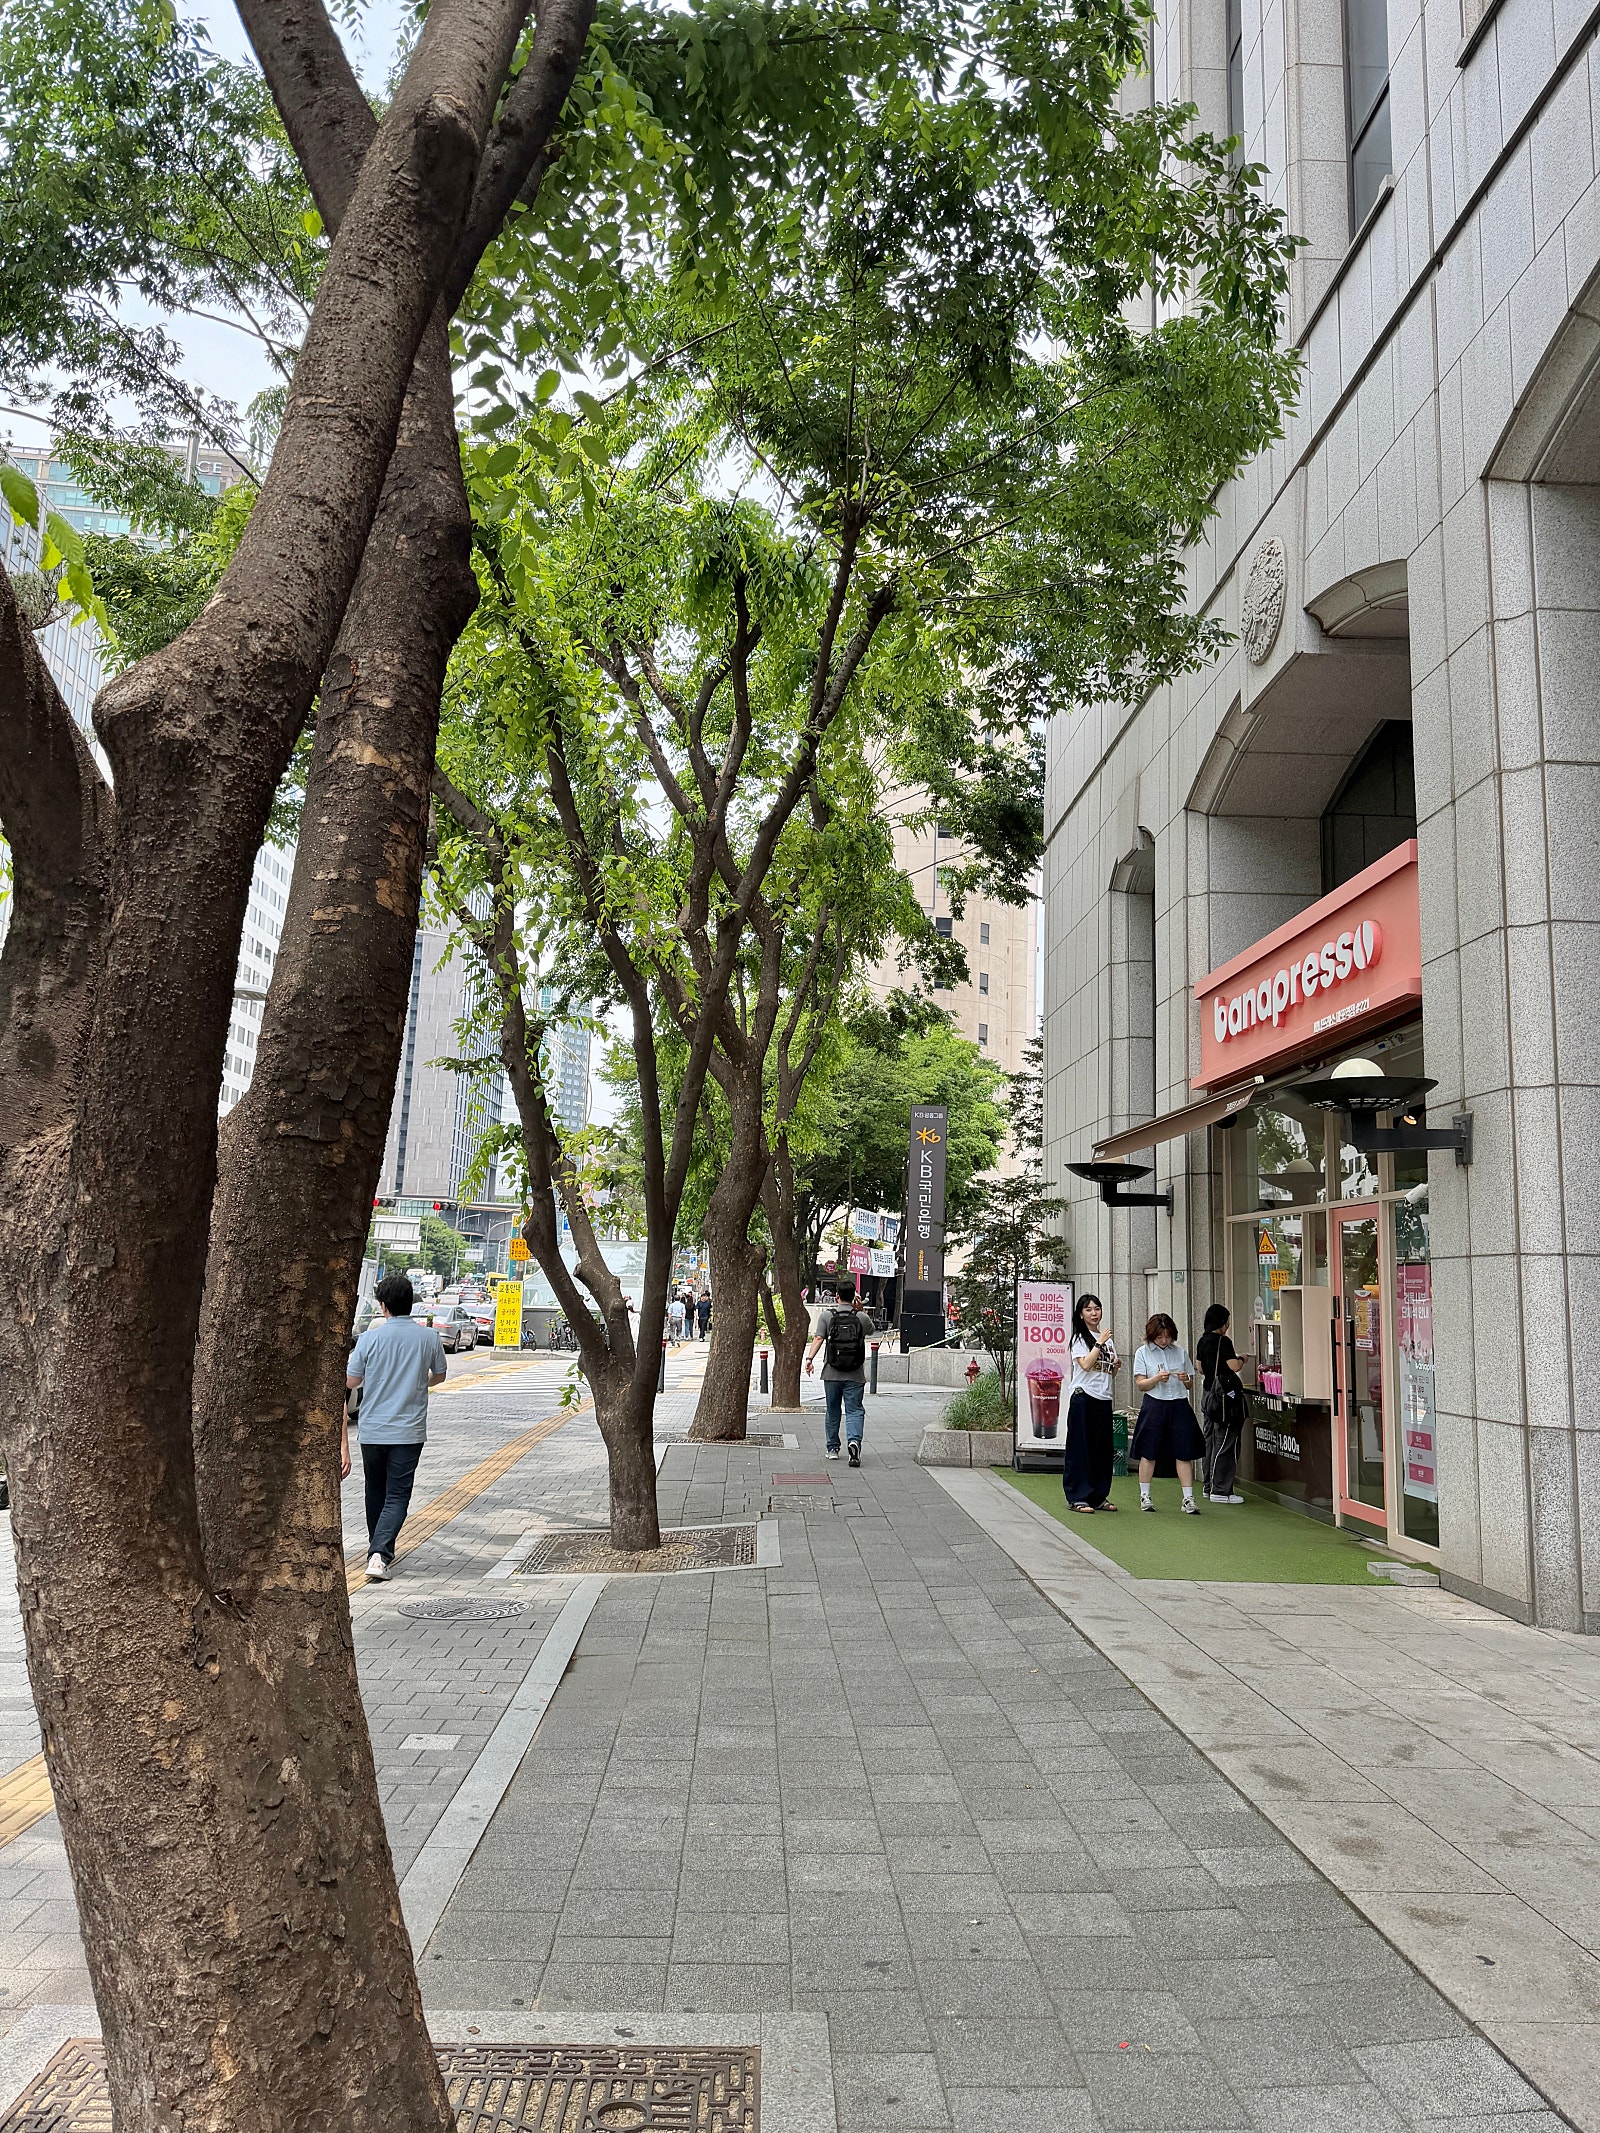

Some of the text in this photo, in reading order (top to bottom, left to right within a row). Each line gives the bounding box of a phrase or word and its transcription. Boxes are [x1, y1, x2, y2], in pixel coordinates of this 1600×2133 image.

[1214, 920, 1380, 1043] banapresso
[917, 1149, 933, 1239] KB국민은행
[498, 1283, 521, 1294] 교통안내
[1023, 1292, 1065, 1303] 빅 아이스
[1023, 1302, 1065, 1313] 아메리카노
[1023, 1312, 1065, 1323] 테이크아웃
[1023, 1326, 1066, 1344] 1800
[1255, 1439, 1267, 1452] TAKE
